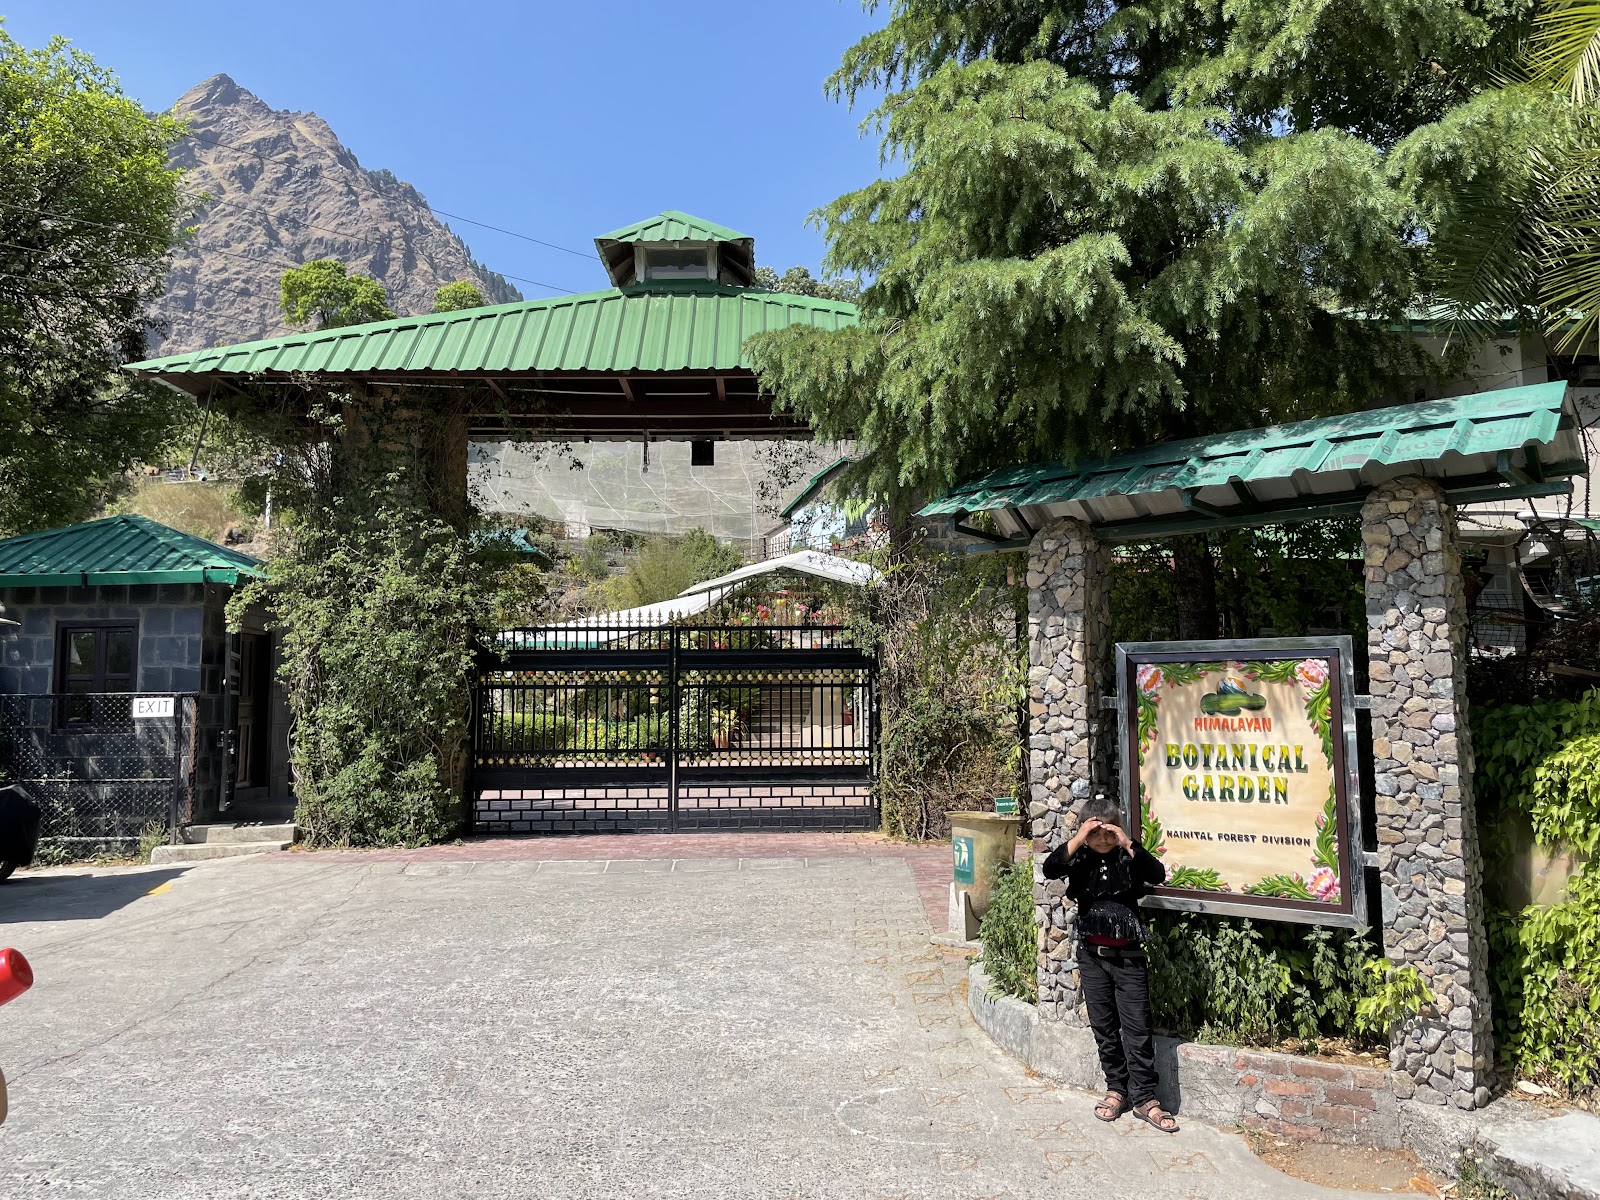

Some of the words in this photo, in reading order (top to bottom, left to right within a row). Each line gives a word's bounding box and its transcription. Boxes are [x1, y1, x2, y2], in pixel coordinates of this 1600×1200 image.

[138, 700, 170, 713] EXIT
[1194, 717, 1272, 732] HIMALAYAN
[1165, 743, 1308, 773] BOTANICAL
[1182, 774, 1288, 804] GARDEN
[1166, 829, 1213, 841] NAINITAL
[1217, 832, 1257, 843] FOREST
[1261, 834, 1311, 847] DIVISION
